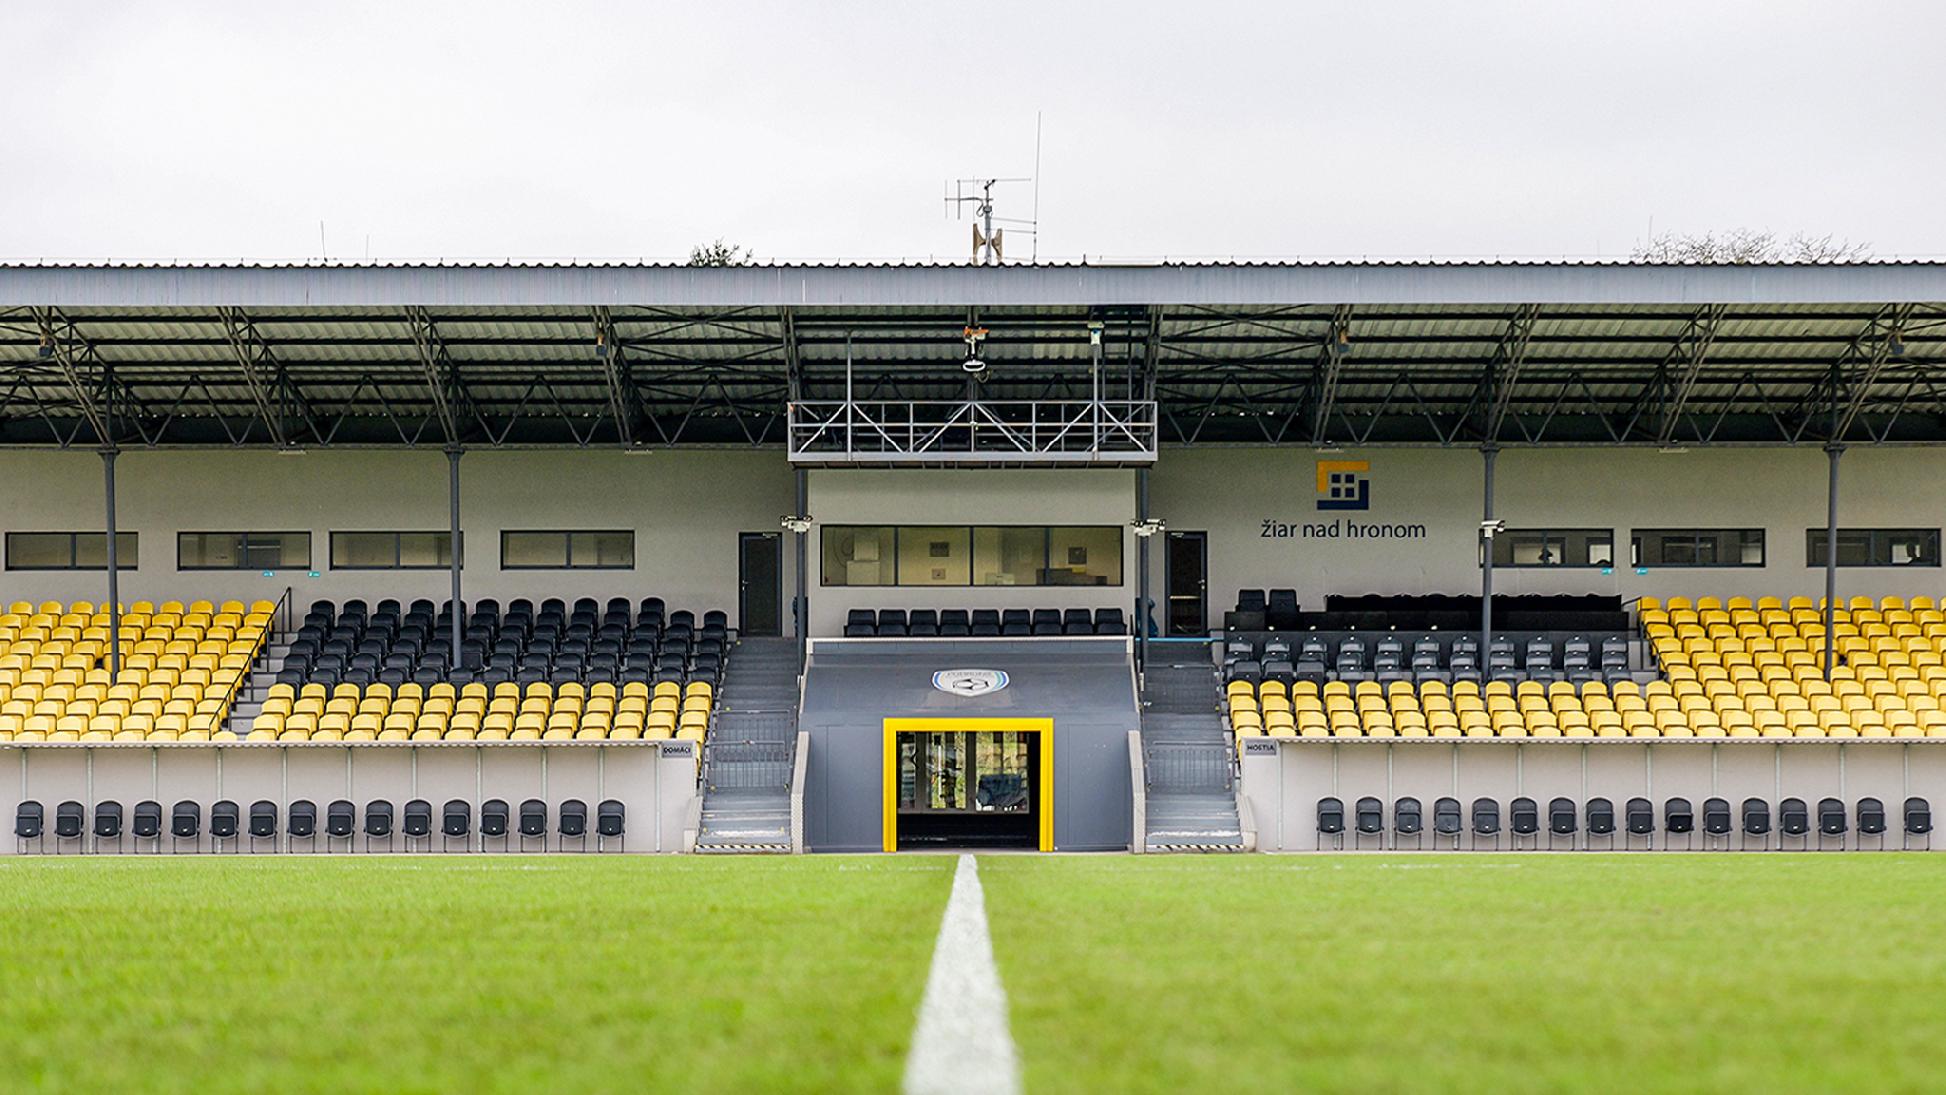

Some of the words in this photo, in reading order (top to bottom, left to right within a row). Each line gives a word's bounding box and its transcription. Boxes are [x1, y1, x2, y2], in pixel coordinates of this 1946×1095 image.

[1260, 519, 1297, 538] žiar
[1303, 519, 1340, 538] nad
[1347, 519, 1426, 538] hronom
